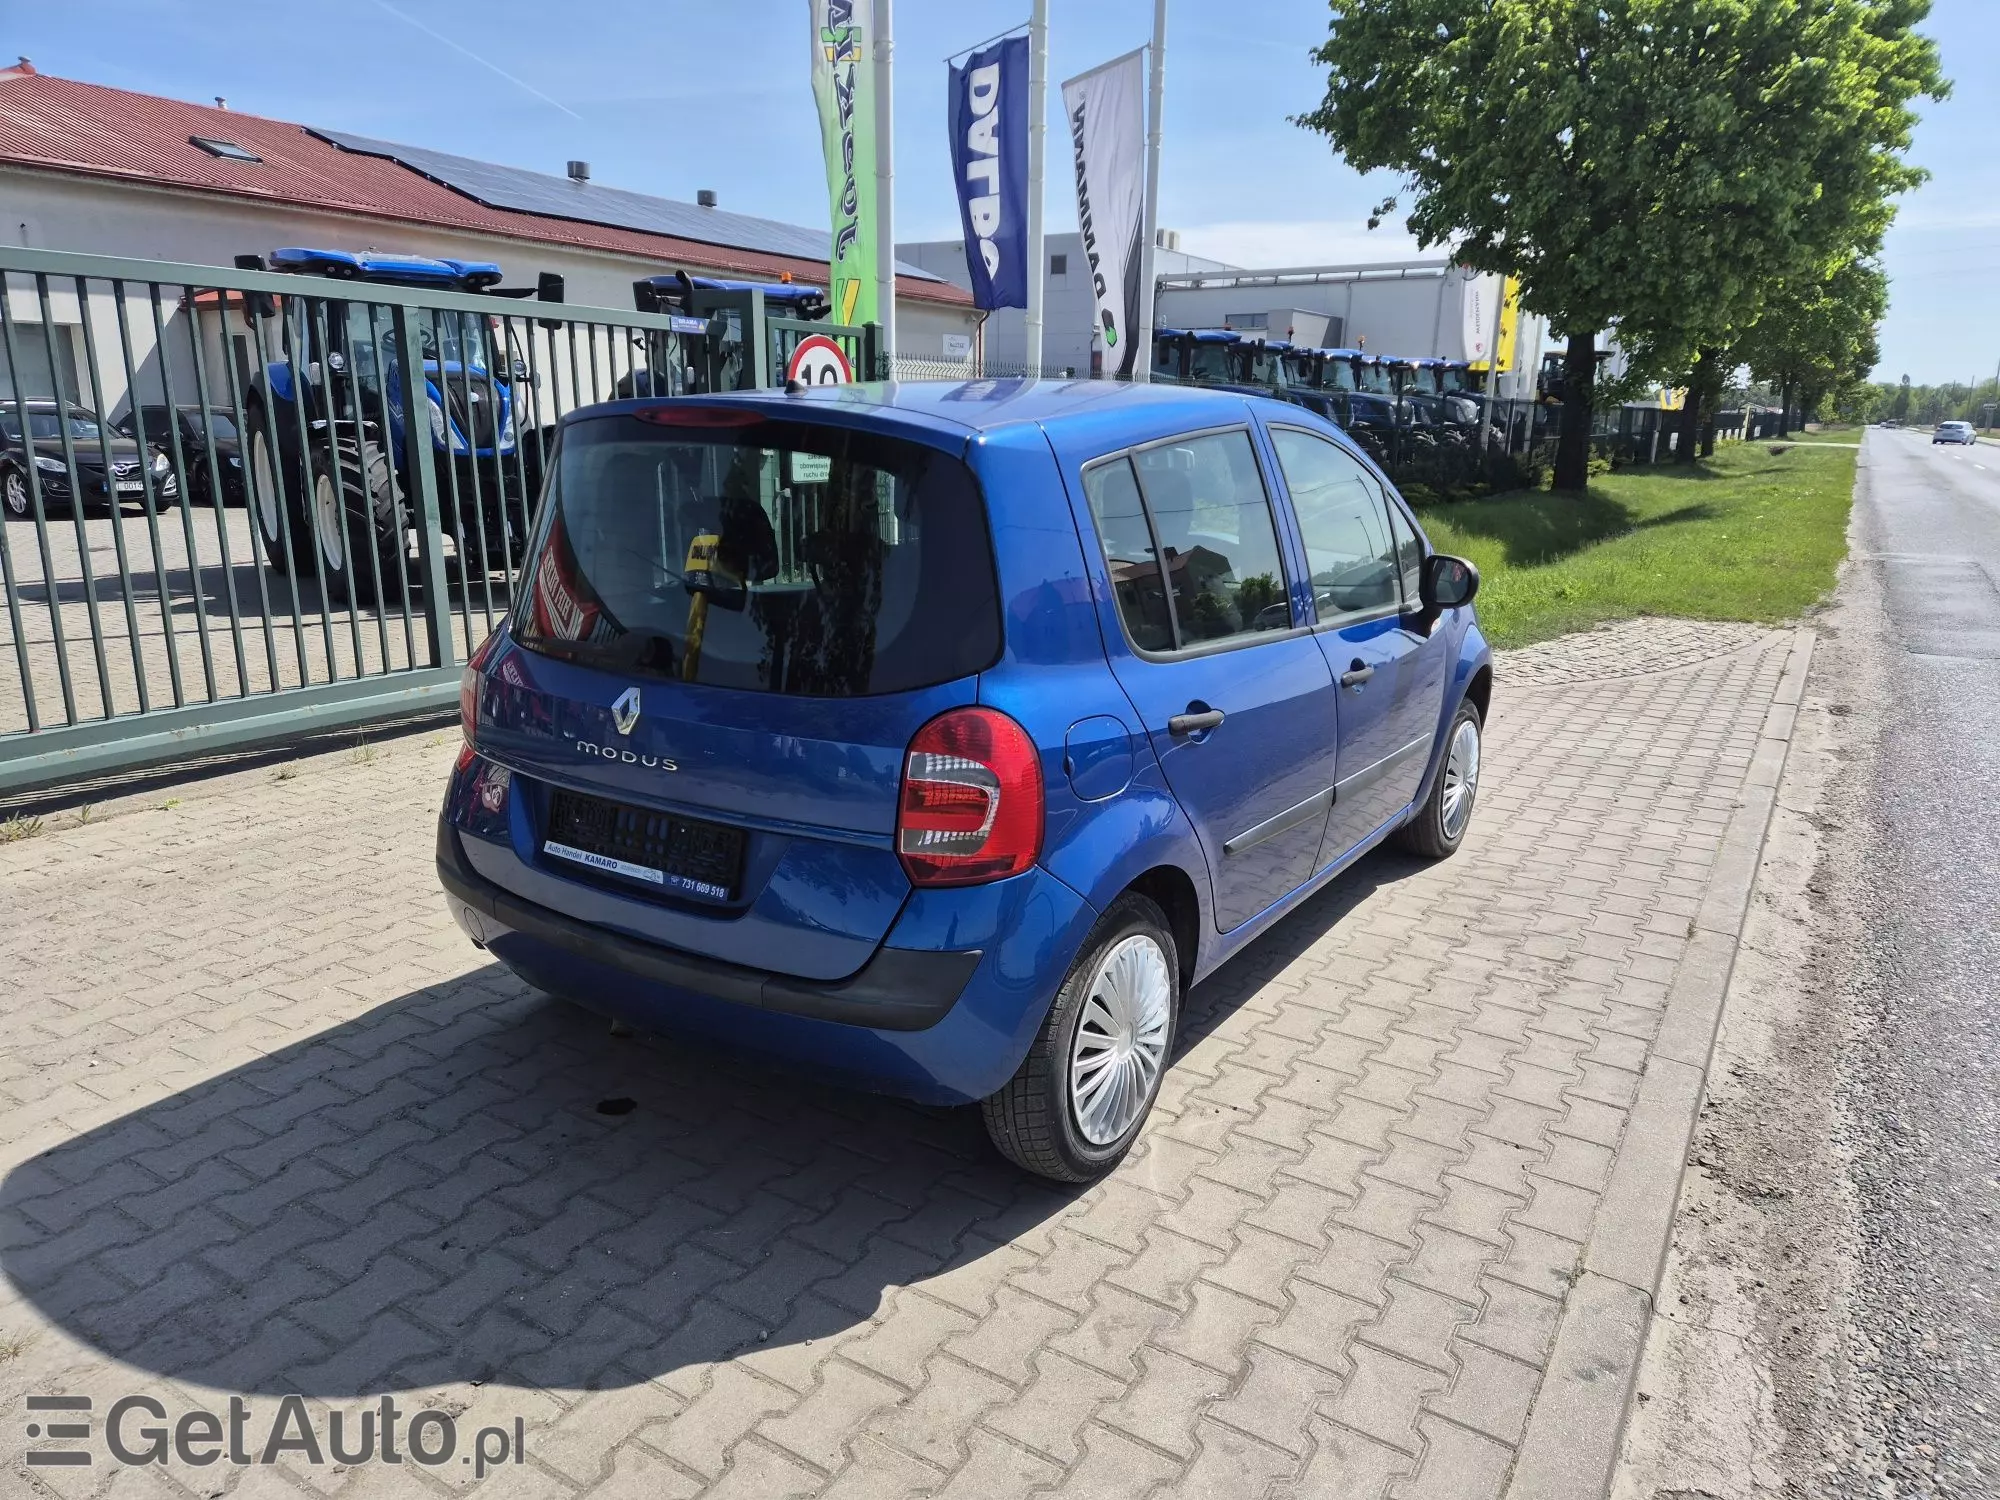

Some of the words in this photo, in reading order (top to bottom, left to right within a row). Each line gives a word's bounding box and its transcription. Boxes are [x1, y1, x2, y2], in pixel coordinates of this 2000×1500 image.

[577, 740, 678, 771] MODUS
[547, 843, 561, 854] Auto
[561, 846, 583, 860] Handel
[584, 854, 618, 869] KAMARO
[682, 878, 695, 890] 731
[696, 882, 709, 893] 669
[711, 886, 725, 898] 518
